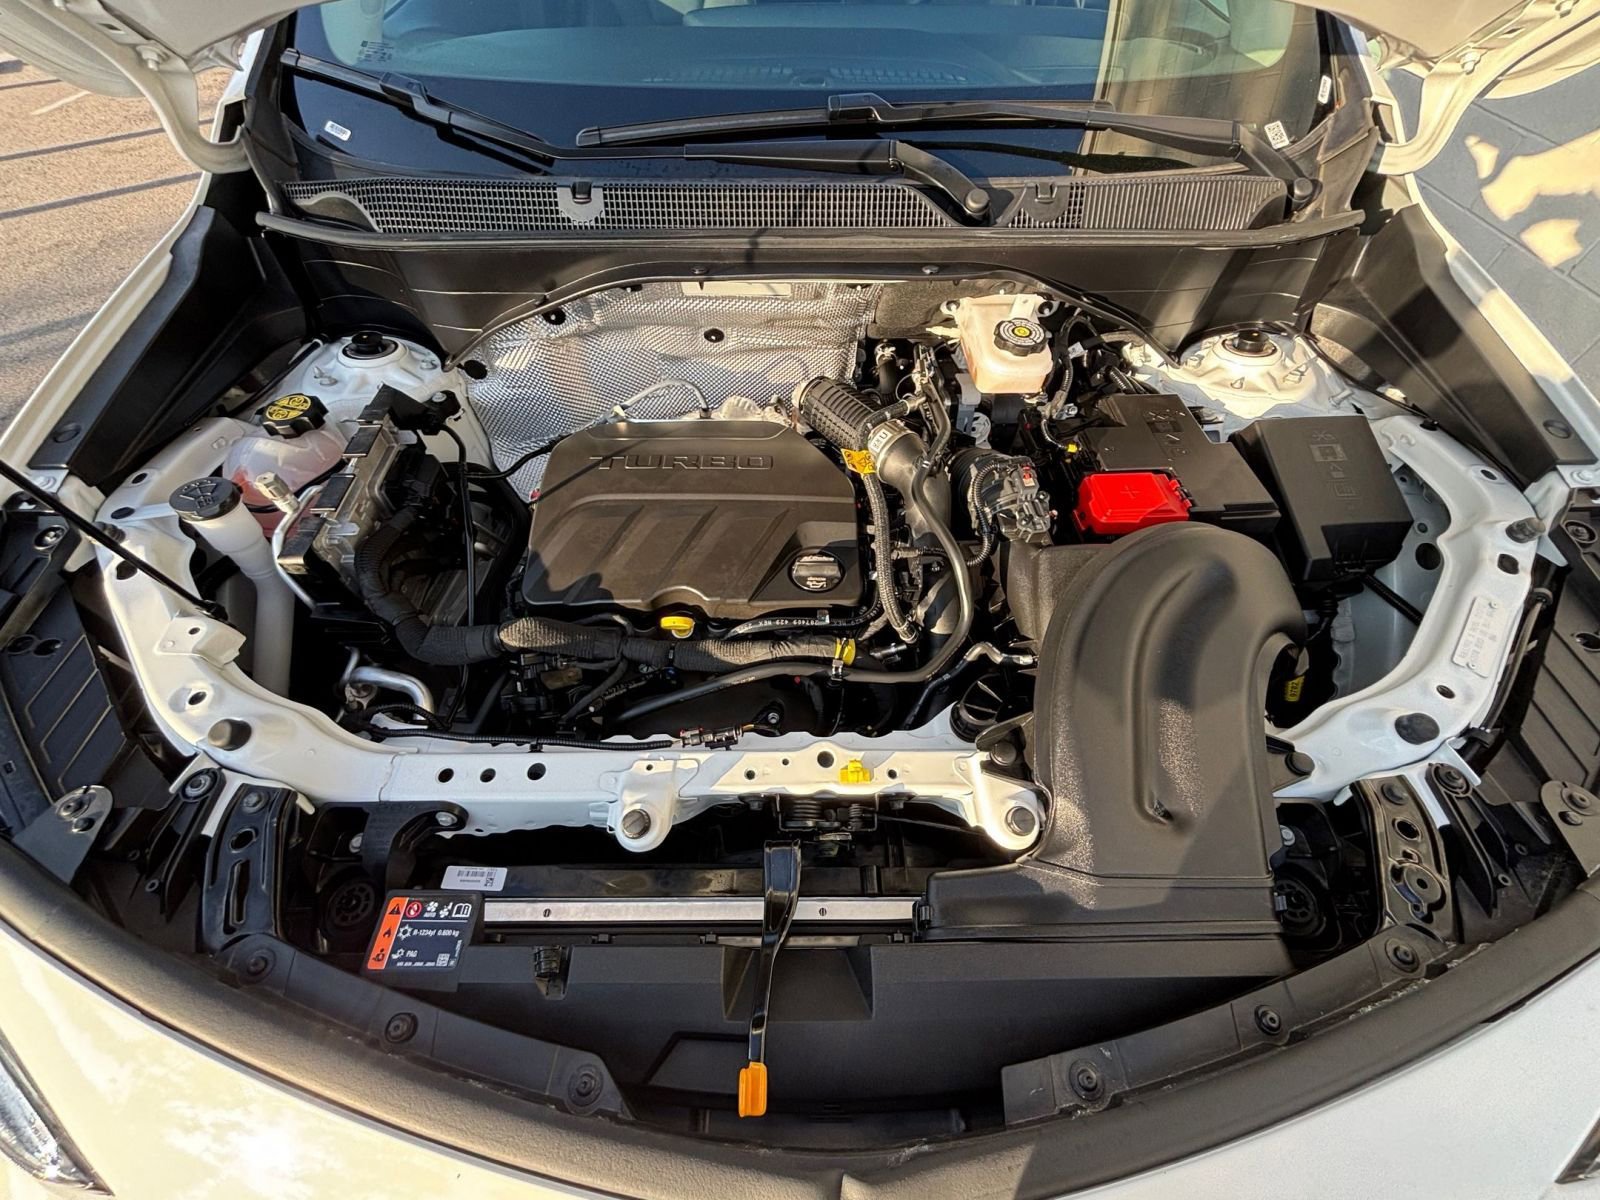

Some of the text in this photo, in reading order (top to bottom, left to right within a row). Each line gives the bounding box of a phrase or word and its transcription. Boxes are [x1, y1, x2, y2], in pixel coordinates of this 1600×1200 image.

[589, 454, 774, 470] TURBO
[452, 929, 460, 938] kg
[406, 950, 418, 958] PAG
